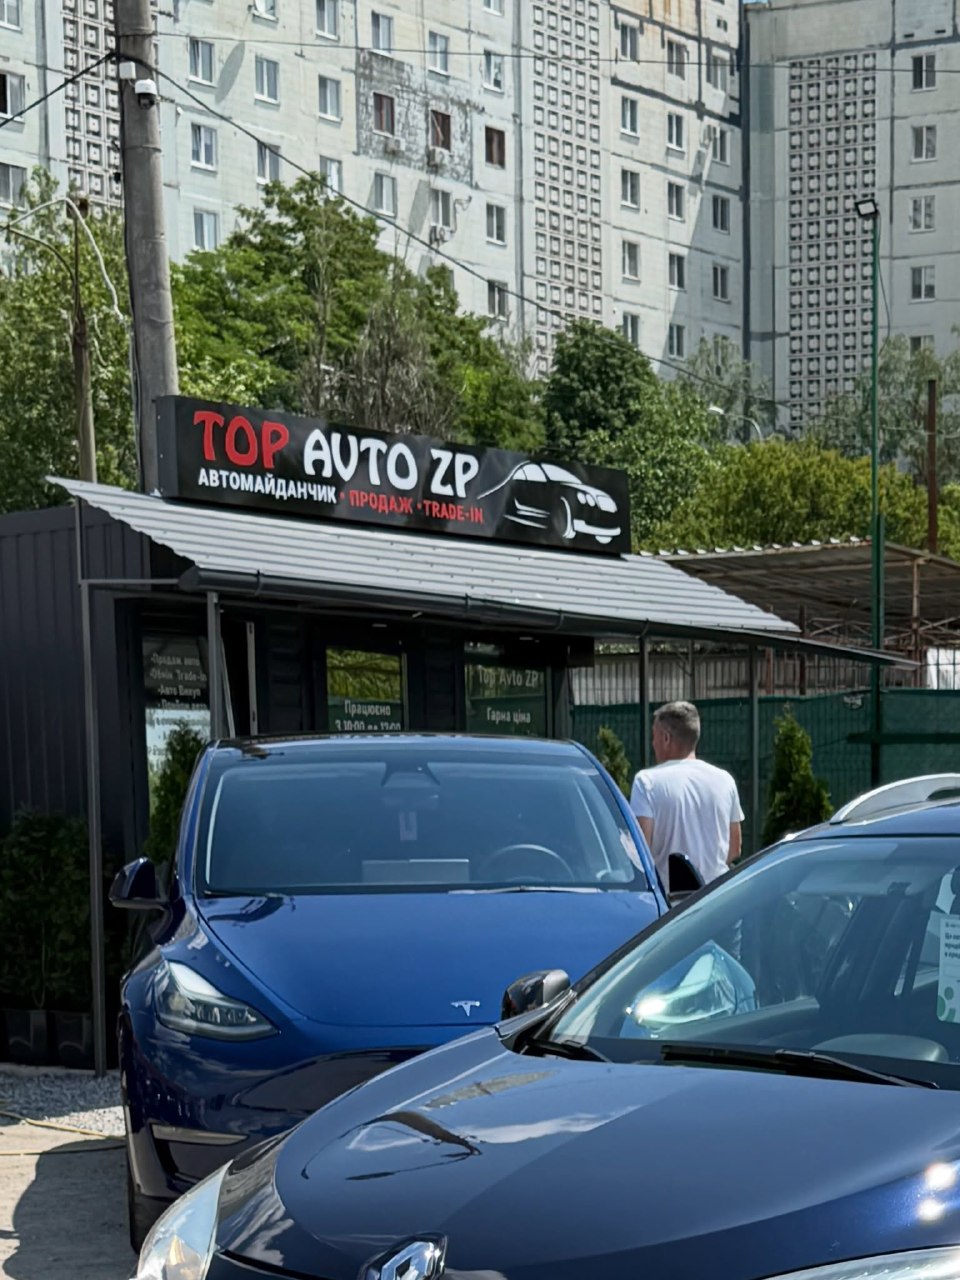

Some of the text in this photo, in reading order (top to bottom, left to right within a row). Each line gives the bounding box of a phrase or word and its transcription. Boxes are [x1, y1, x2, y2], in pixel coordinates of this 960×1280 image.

[193, 410, 479, 498] TOP AVTO ZP
[198, 467, 483, 523] АВТОМАЙДАНЧИК ПРОДАЖ TRADE-IN
[499, 667, 523, 688] Avto
[525, 669, 539, 688] ZP
